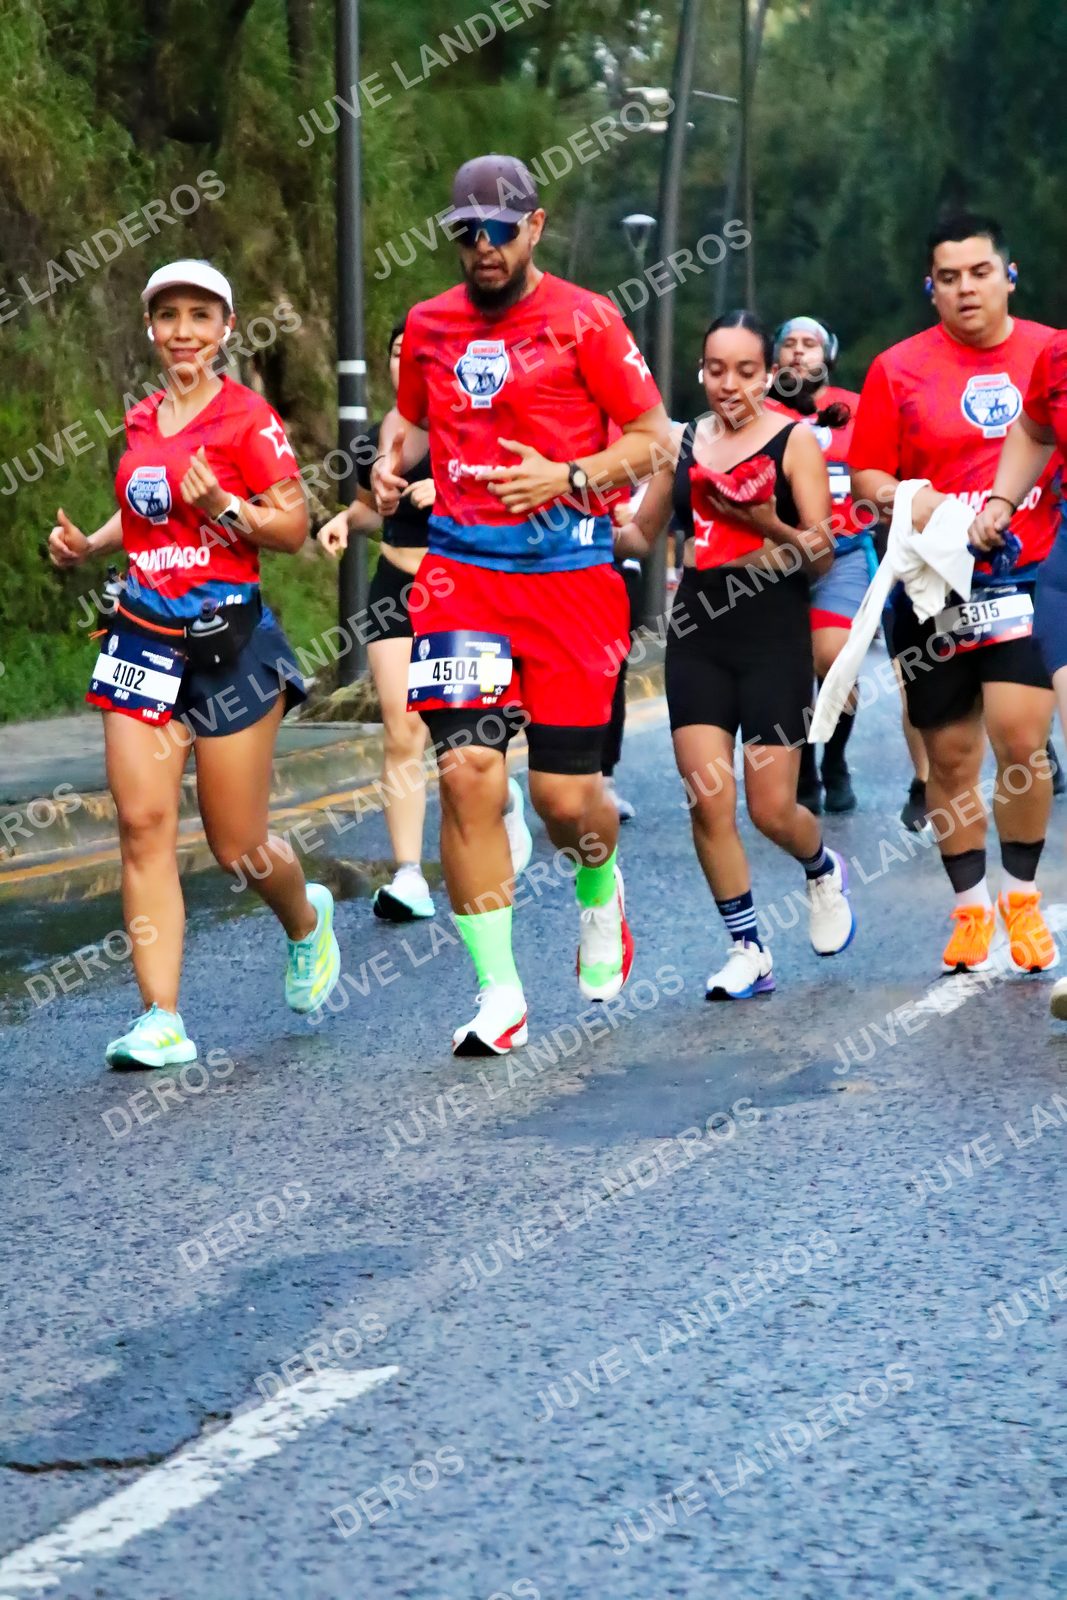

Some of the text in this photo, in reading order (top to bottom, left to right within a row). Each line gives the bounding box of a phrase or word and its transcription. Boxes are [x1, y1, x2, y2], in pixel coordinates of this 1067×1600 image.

[958, 602, 1000, 626] 5315
[112, 662, 145, 690] 4102
[432, 660, 478, 681] 4504
